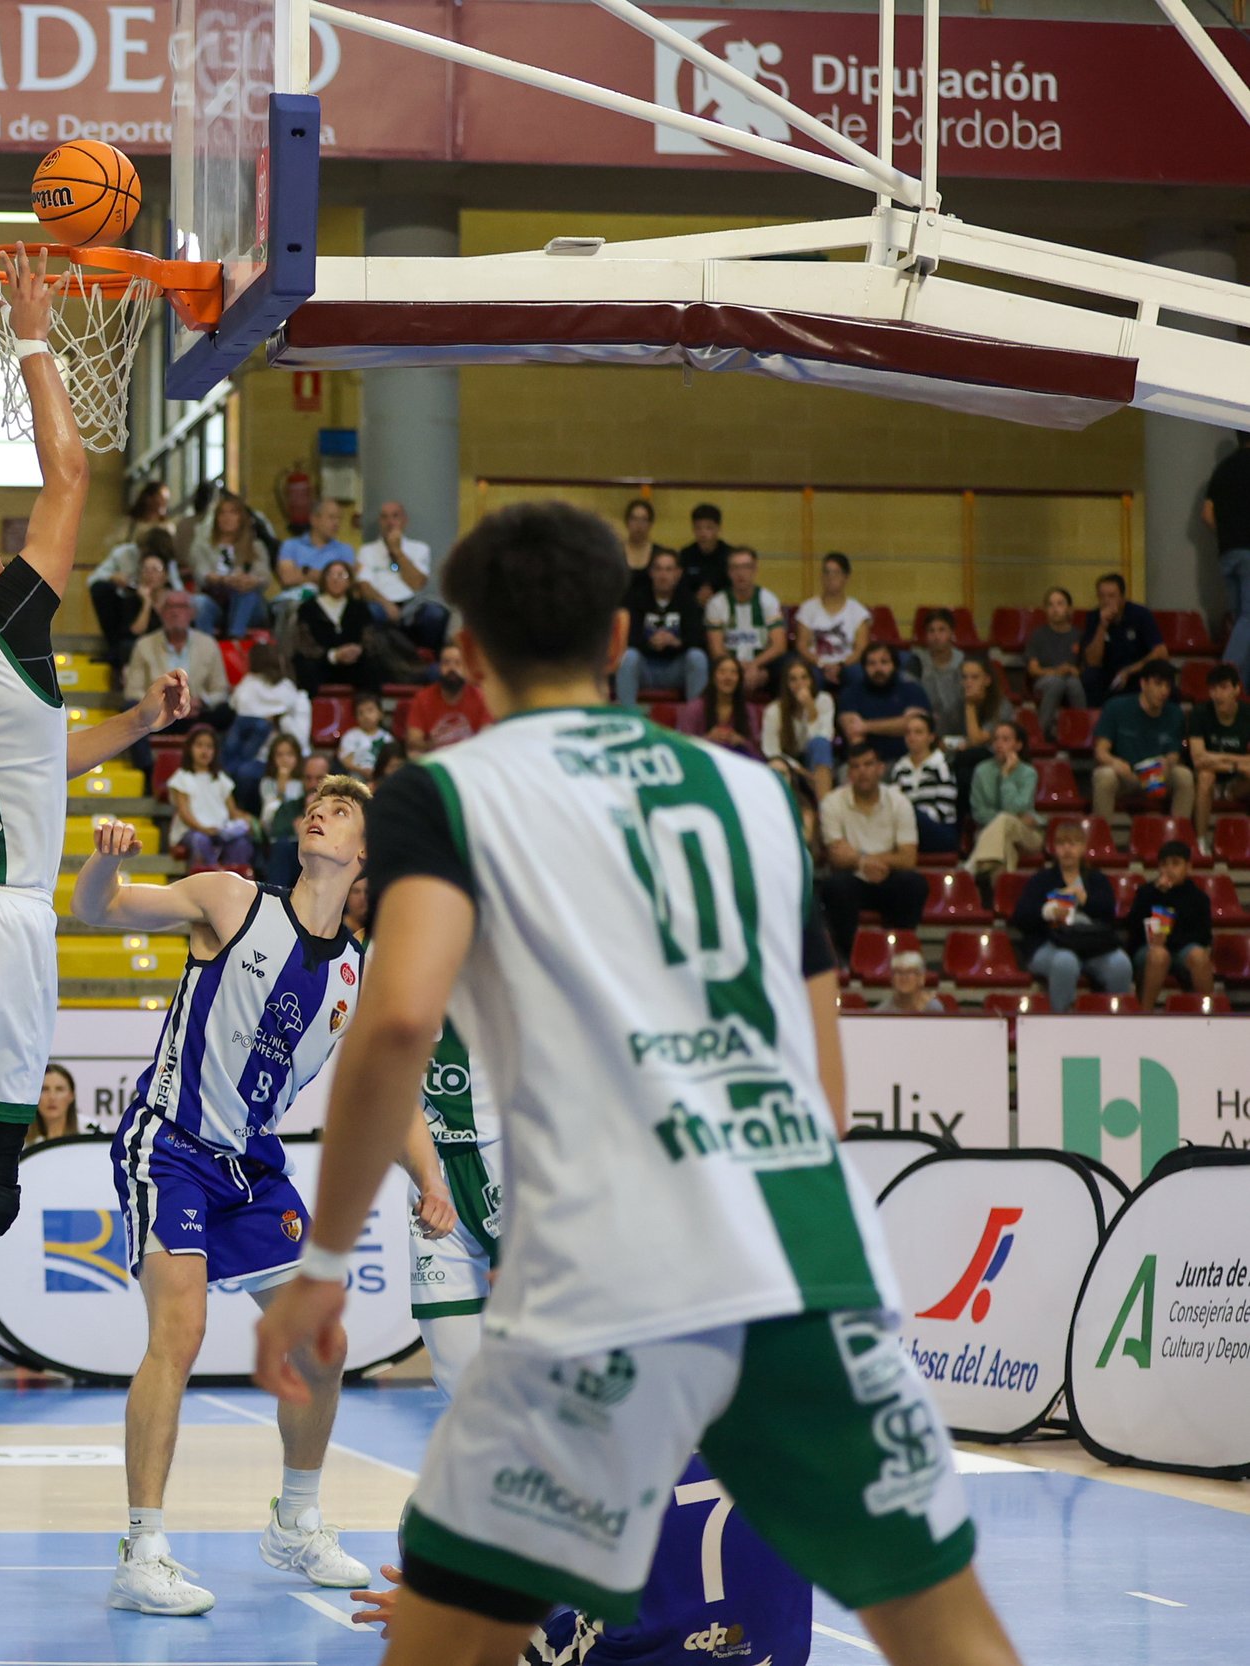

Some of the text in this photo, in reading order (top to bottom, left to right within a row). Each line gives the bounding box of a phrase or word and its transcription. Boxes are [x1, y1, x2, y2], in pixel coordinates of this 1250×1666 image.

[812, 54, 1058, 105] Dipuación
[15, 113, 49, 141] de
[241, 960, 266, 979] vive
[251, 1070, 274, 1103] 9
[181, 1221, 204, 1232] vive
[1176, 1258, 1247, 1288] Junta de
[1170, 1297, 1234, 1329] Consejería
[1161, 1335, 1205, 1358] Cultura
[1204, 1342, 1216, 1365] y
[951, 1343, 980, 1386] del
[984, 1349, 1039, 1393] Acero
[674, 1478, 735, 1604] 7
